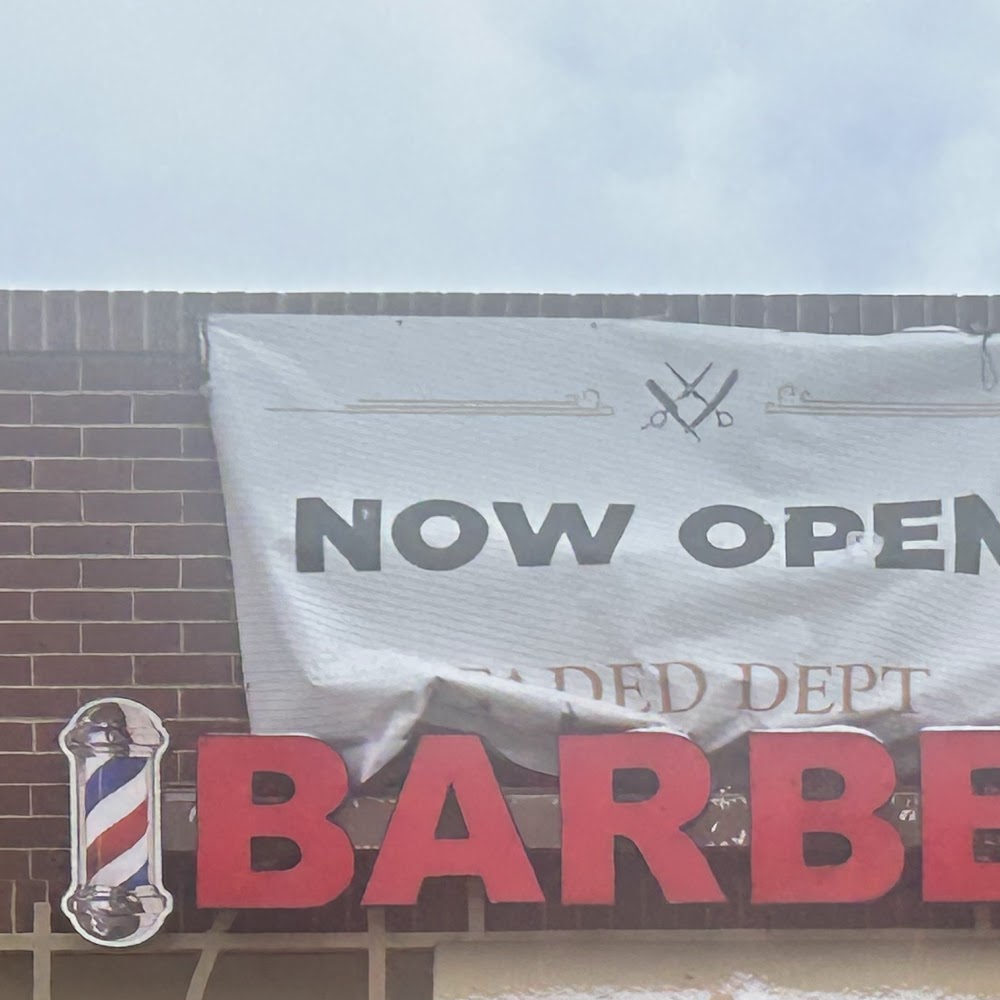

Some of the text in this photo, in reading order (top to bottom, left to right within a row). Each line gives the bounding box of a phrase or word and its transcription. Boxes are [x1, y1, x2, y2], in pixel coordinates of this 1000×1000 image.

[295, 497, 636, 573] NOW
[460, 661, 930, 715] DED DEPT
